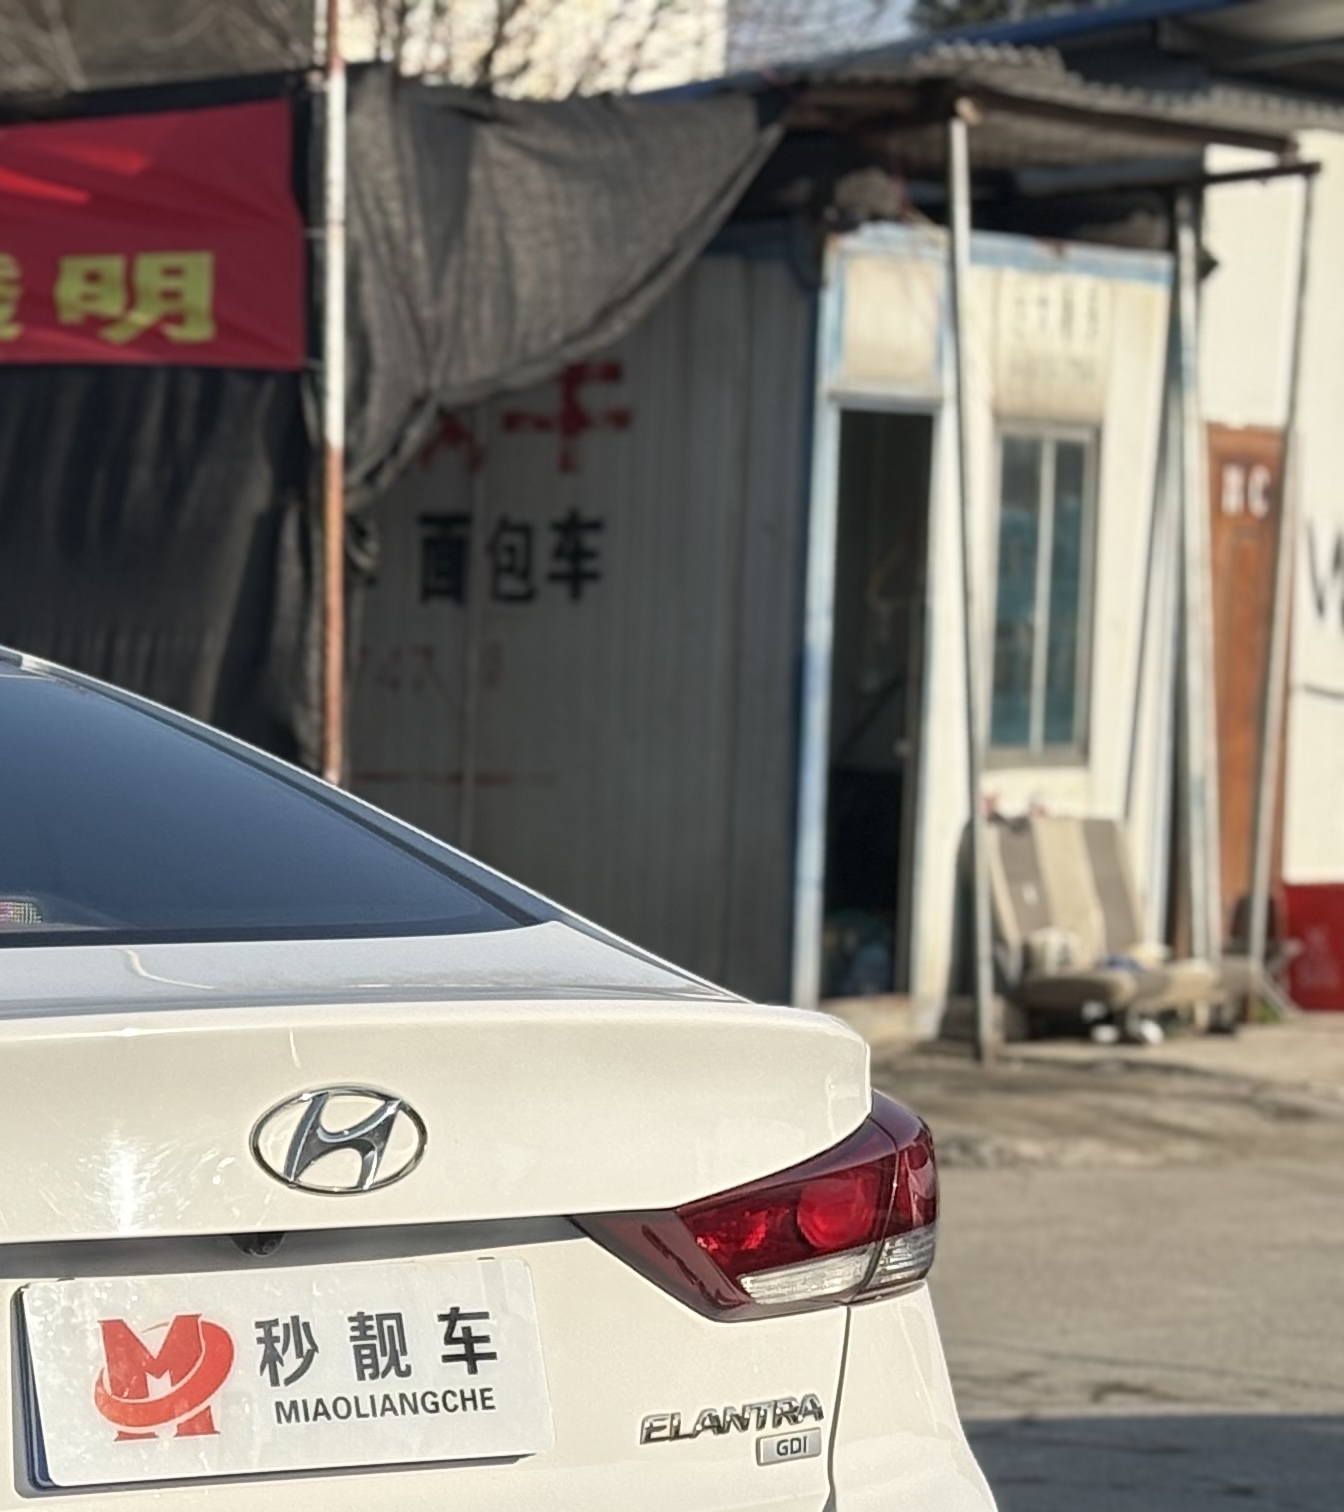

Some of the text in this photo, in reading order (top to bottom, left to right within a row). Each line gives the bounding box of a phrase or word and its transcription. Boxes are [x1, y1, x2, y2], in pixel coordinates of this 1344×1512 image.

[418, 507, 605, 607] 面包车
[254, 1306, 498, 1388] 秒靓车
[274, 1387, 497, 1425] MIAOLIANGCHE
[639, 1393, 825, 1446] ELANTRA
[775, 1435, 809, 1458] GDI
